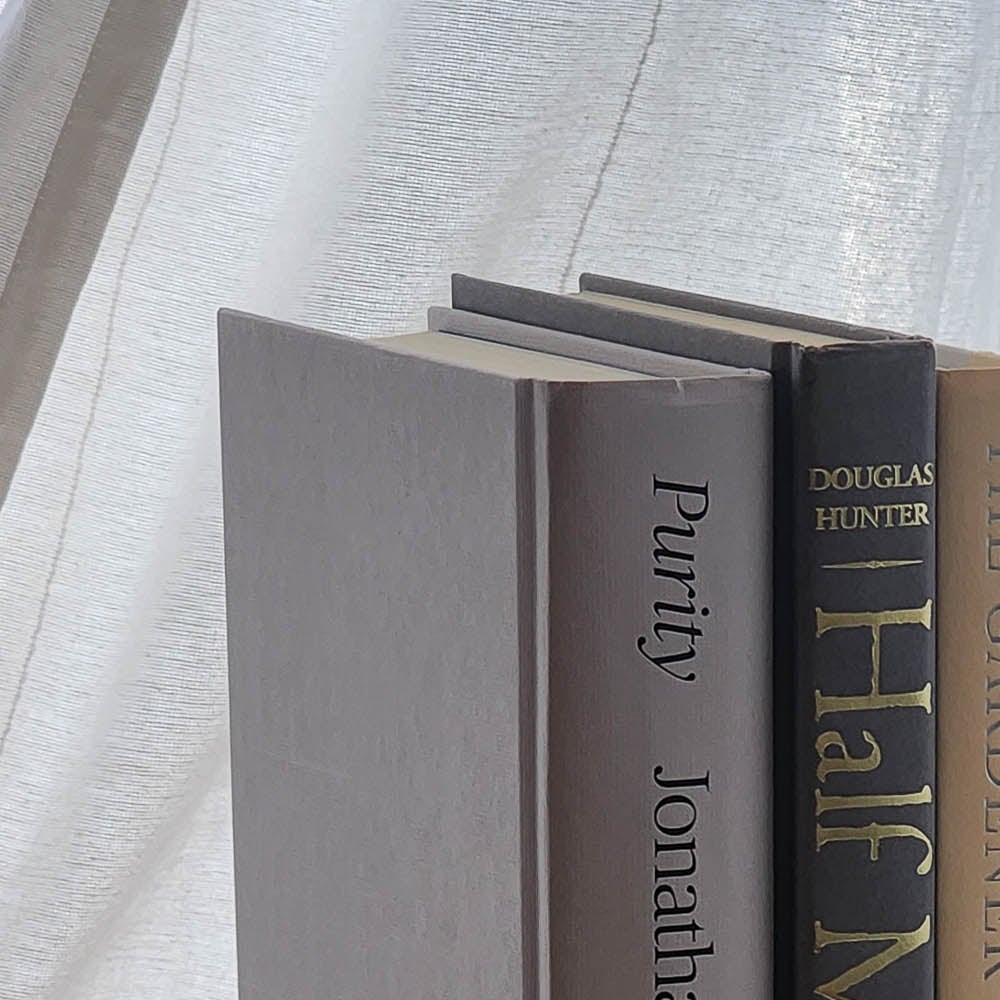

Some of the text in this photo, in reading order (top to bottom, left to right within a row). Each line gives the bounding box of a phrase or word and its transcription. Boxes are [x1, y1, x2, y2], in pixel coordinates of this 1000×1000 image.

[808, 462, 934, 492] DOUGLAS
[815, 502, 931, 531] HUNTER
[637, 473, 710, 682] Purity
[814, 598, 933, 876] Half
